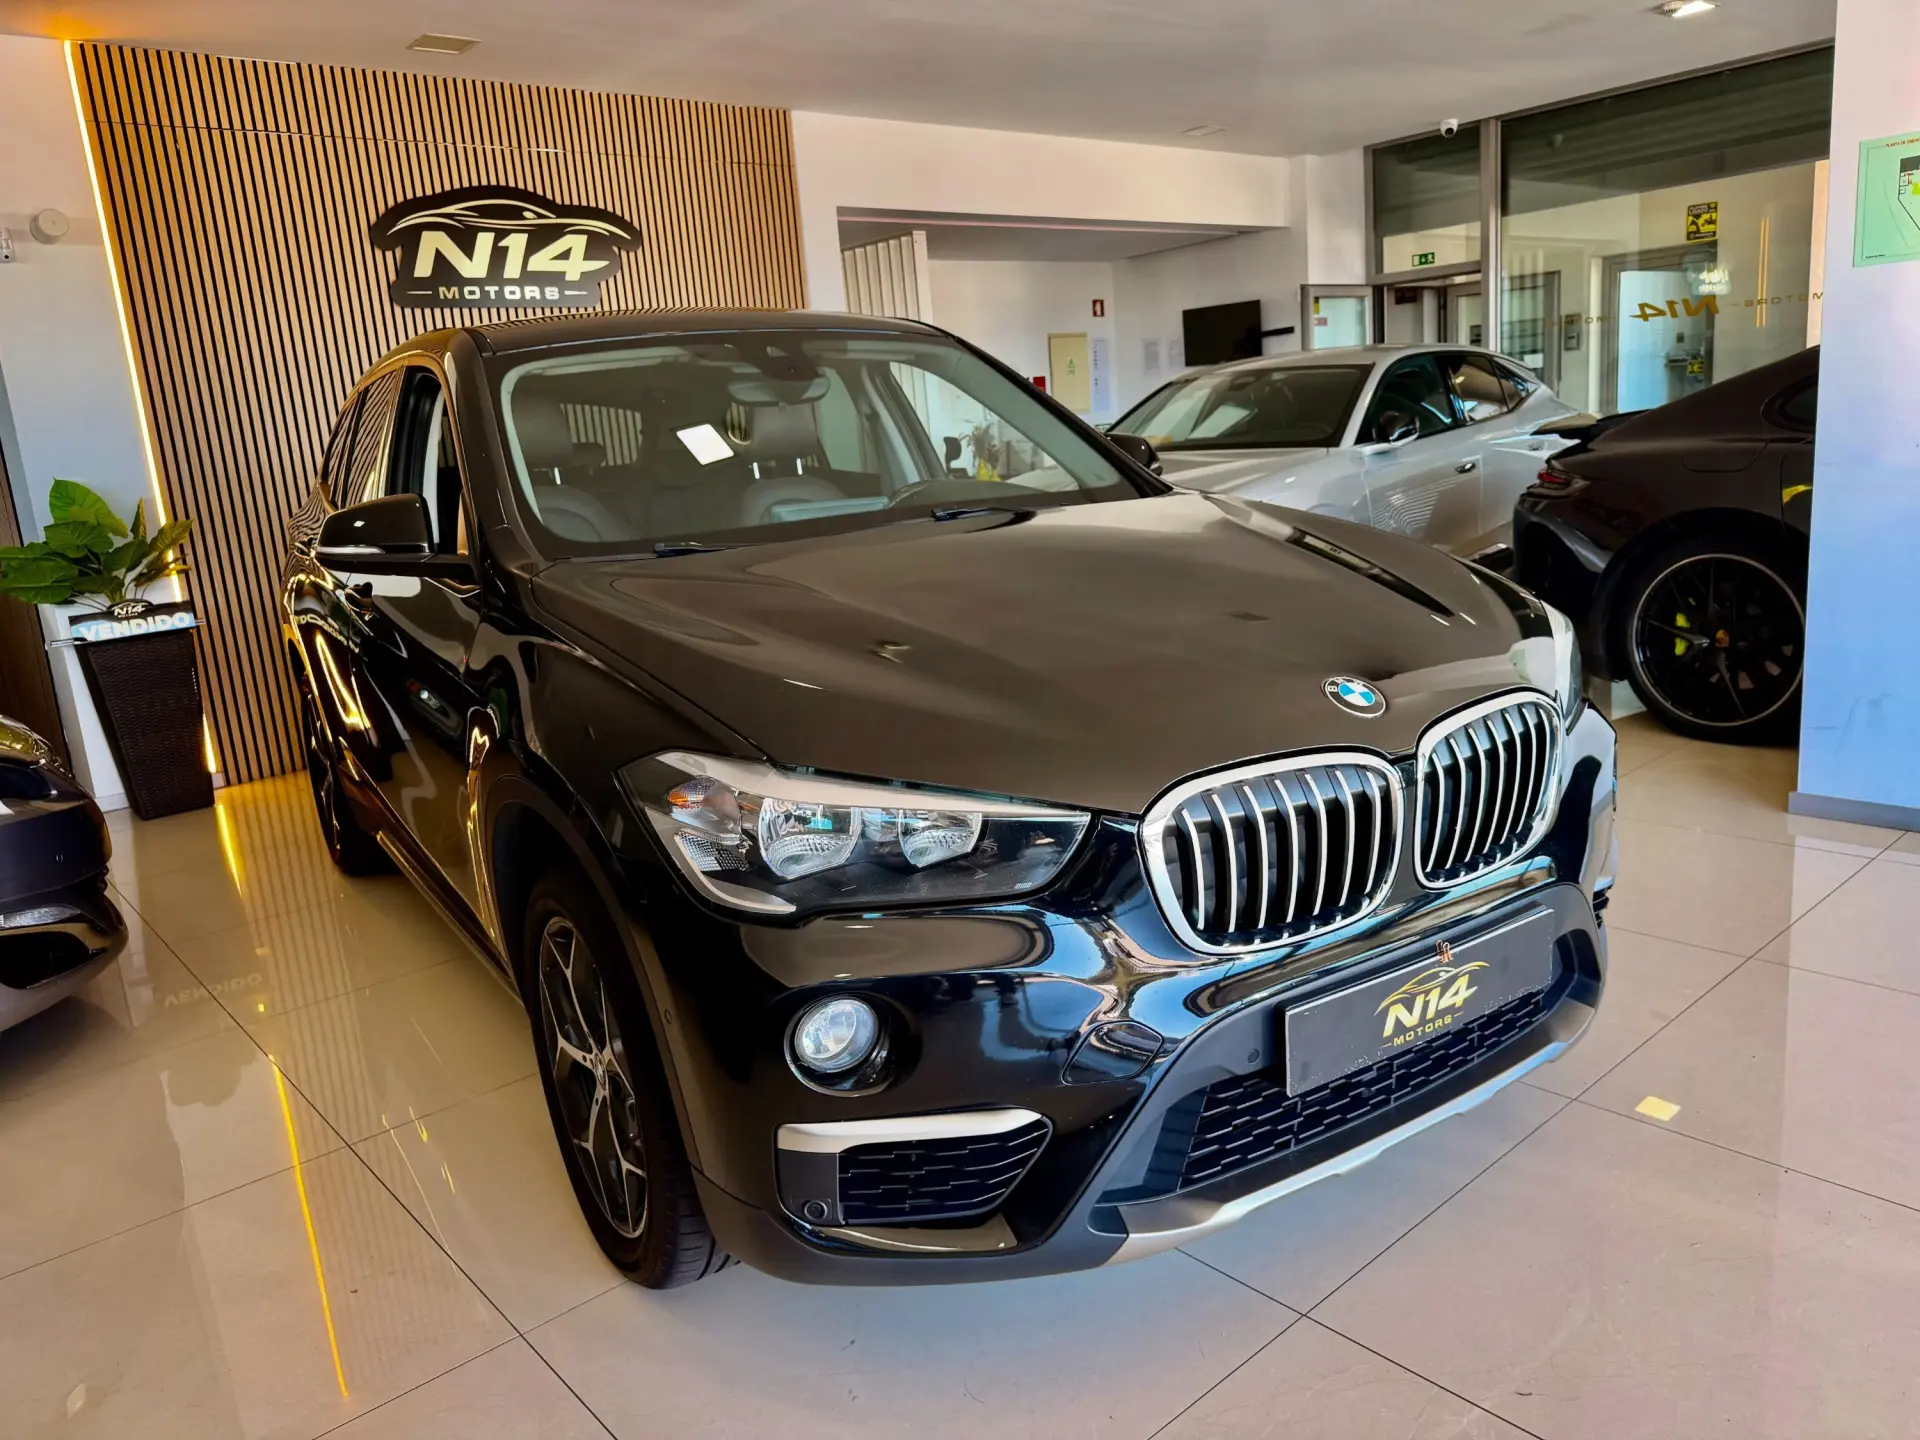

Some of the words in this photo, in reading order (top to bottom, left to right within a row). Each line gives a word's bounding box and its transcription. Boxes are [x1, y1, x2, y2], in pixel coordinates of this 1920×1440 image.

[413, 230, 610, 281] N14
[438, 285, 560, 300] MOTORS
[114, 604, 147, 616] N14
[79, 611, 190, 642] VENDIDO
[1383, 974, 1478, 1038] N14
[1393, 1014, 1453, 1047] MOTORS
